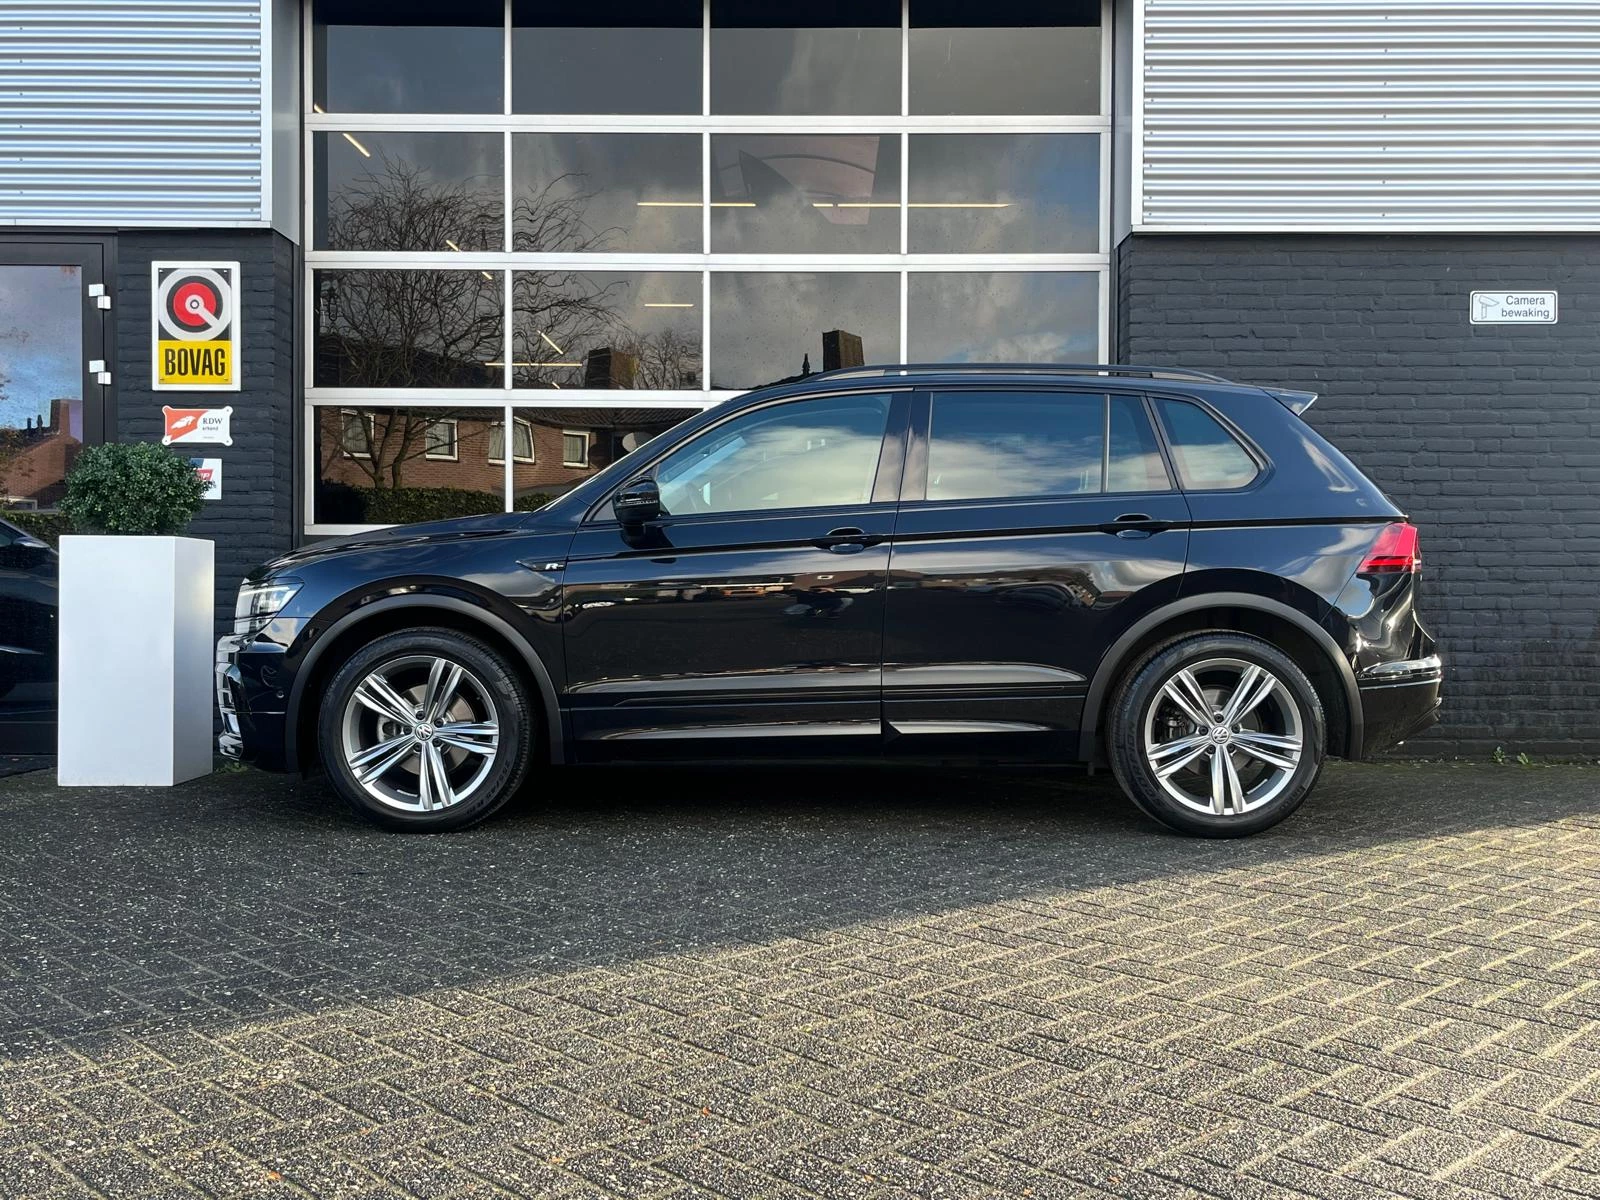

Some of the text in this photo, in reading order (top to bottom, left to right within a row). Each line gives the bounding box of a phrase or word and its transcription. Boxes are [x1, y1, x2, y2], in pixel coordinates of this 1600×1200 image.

[1505, 295, 1546, 305] Camera
[1501, 308, 1550, 320] bewaking
[164, 347, 226, 376] BOVAG
